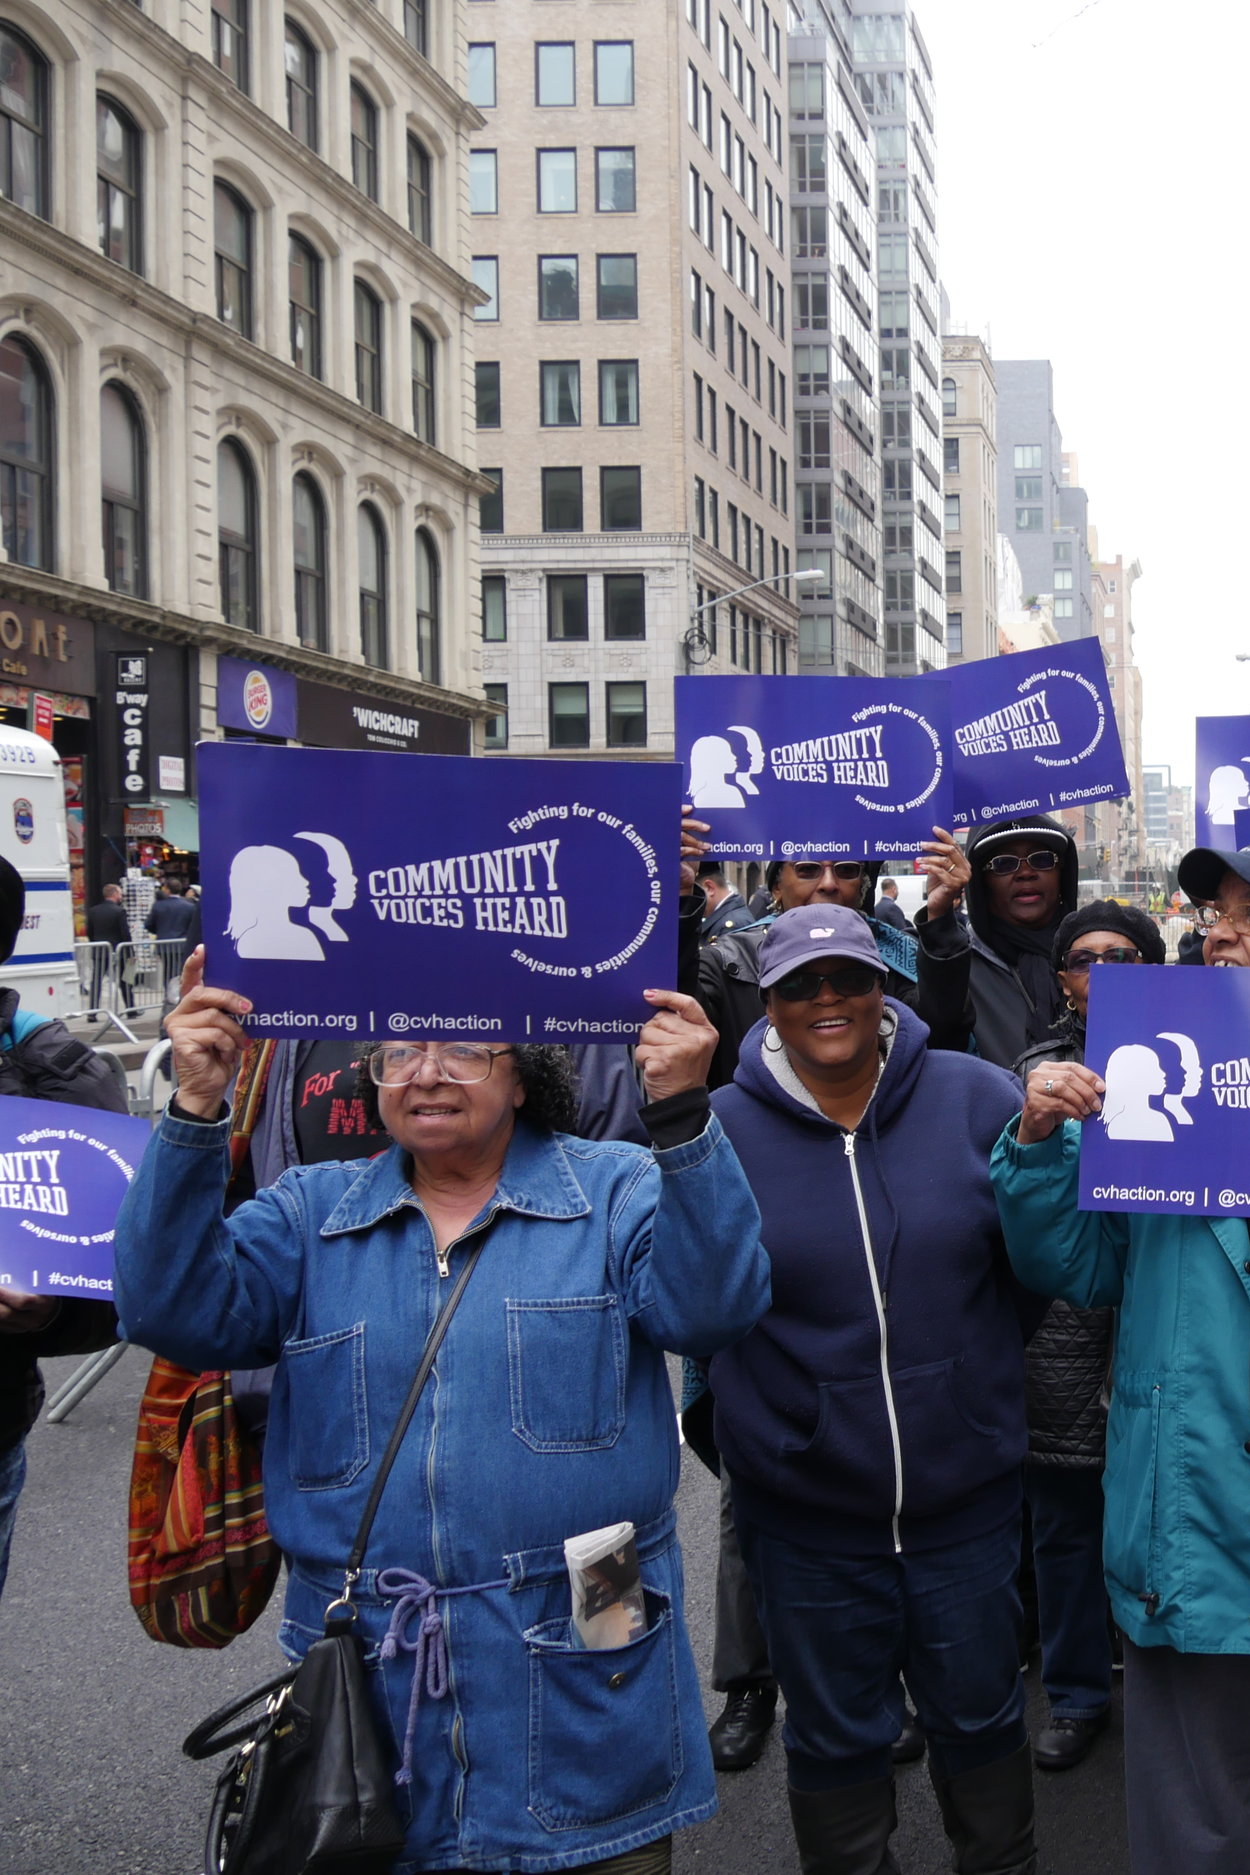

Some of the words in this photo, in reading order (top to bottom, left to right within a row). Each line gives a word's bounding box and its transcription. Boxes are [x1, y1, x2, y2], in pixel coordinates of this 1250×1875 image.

[1047, 668, 1060, 676] for
[1061, 670, 1075, 678] our
[248, 684, 267, 698] BURGER
[1017, 672, 1047, 692] Fighting
[1075, 673, 1099, 701] families,
[116, 691, 148, 707] B'way
[248, 694, 267, 712] KING
[888, 703, 902, 713] for
[1096, 701, 1104, 715] our
[353, 706, 419, 738] 'WICHCRAFT
[852, 704, 887, 722] Fighting
[903, 709, 918, 719] our
[955, 690, 1050, 744] COMMUNITY
[918, 716, 940, 750] families,
[959, 734, 1007, 756] VOICES
[1009, 721, 1060, 750] HEARD
[1078, 716, 1104, 759] communities
[123, 708, 145, 791] cafe
[771, 725, 883, 764] COMMUNITY
[1034, 755, 1070, 767] ourselves
[1071, 756, 1078, 764] &
[772, 764, 827, 783] VOICES
[832, 760, 889, 787] HEARD
[906, 768, 941, 809] communities
[572, 802, 595, 817] for
[855, 795, 895, 812] ourselves
[897, 805, 904, 813] &
[981, 800, 1038, 818] @cvhaction
[1059, 784, 1114, 802] #cvhaction
[125, 823, 162, 834] PHOTOS
[508, 805, 568, 833] Fighting
[597, 812, 622, 828] our
[622, 824, 658, 878] families,
[782, 840, 849, 855] @cvhaction
[875, 841, 922, 852] #cvhact
[368, 839, 559, 896] COMMUNITY
[651, 880, 661, 904] our
[371, 898, 464, 928] VOICES
[473, 896, 567, 938] HEARD
[595, 907, 658, 973] communities
[510, 949, 577, 976] ourselves
[581, 966, 592, 978] &
[387, 1012, 501, 1031] @cvhaction
[301, 1069, 342, 1108] For
[17, 1128, 66, 1145] Fighting
[68, 1129, 87, 1142] for
[88, 1138, 108, 1151] our
[1093, 1185, 1194, 1206] cvhaction.org
[20, 1220, 78, 1244] ourselves
[80, 1236, 90, 1246] &
[48, 1272, 113, 1291] #cvhact
